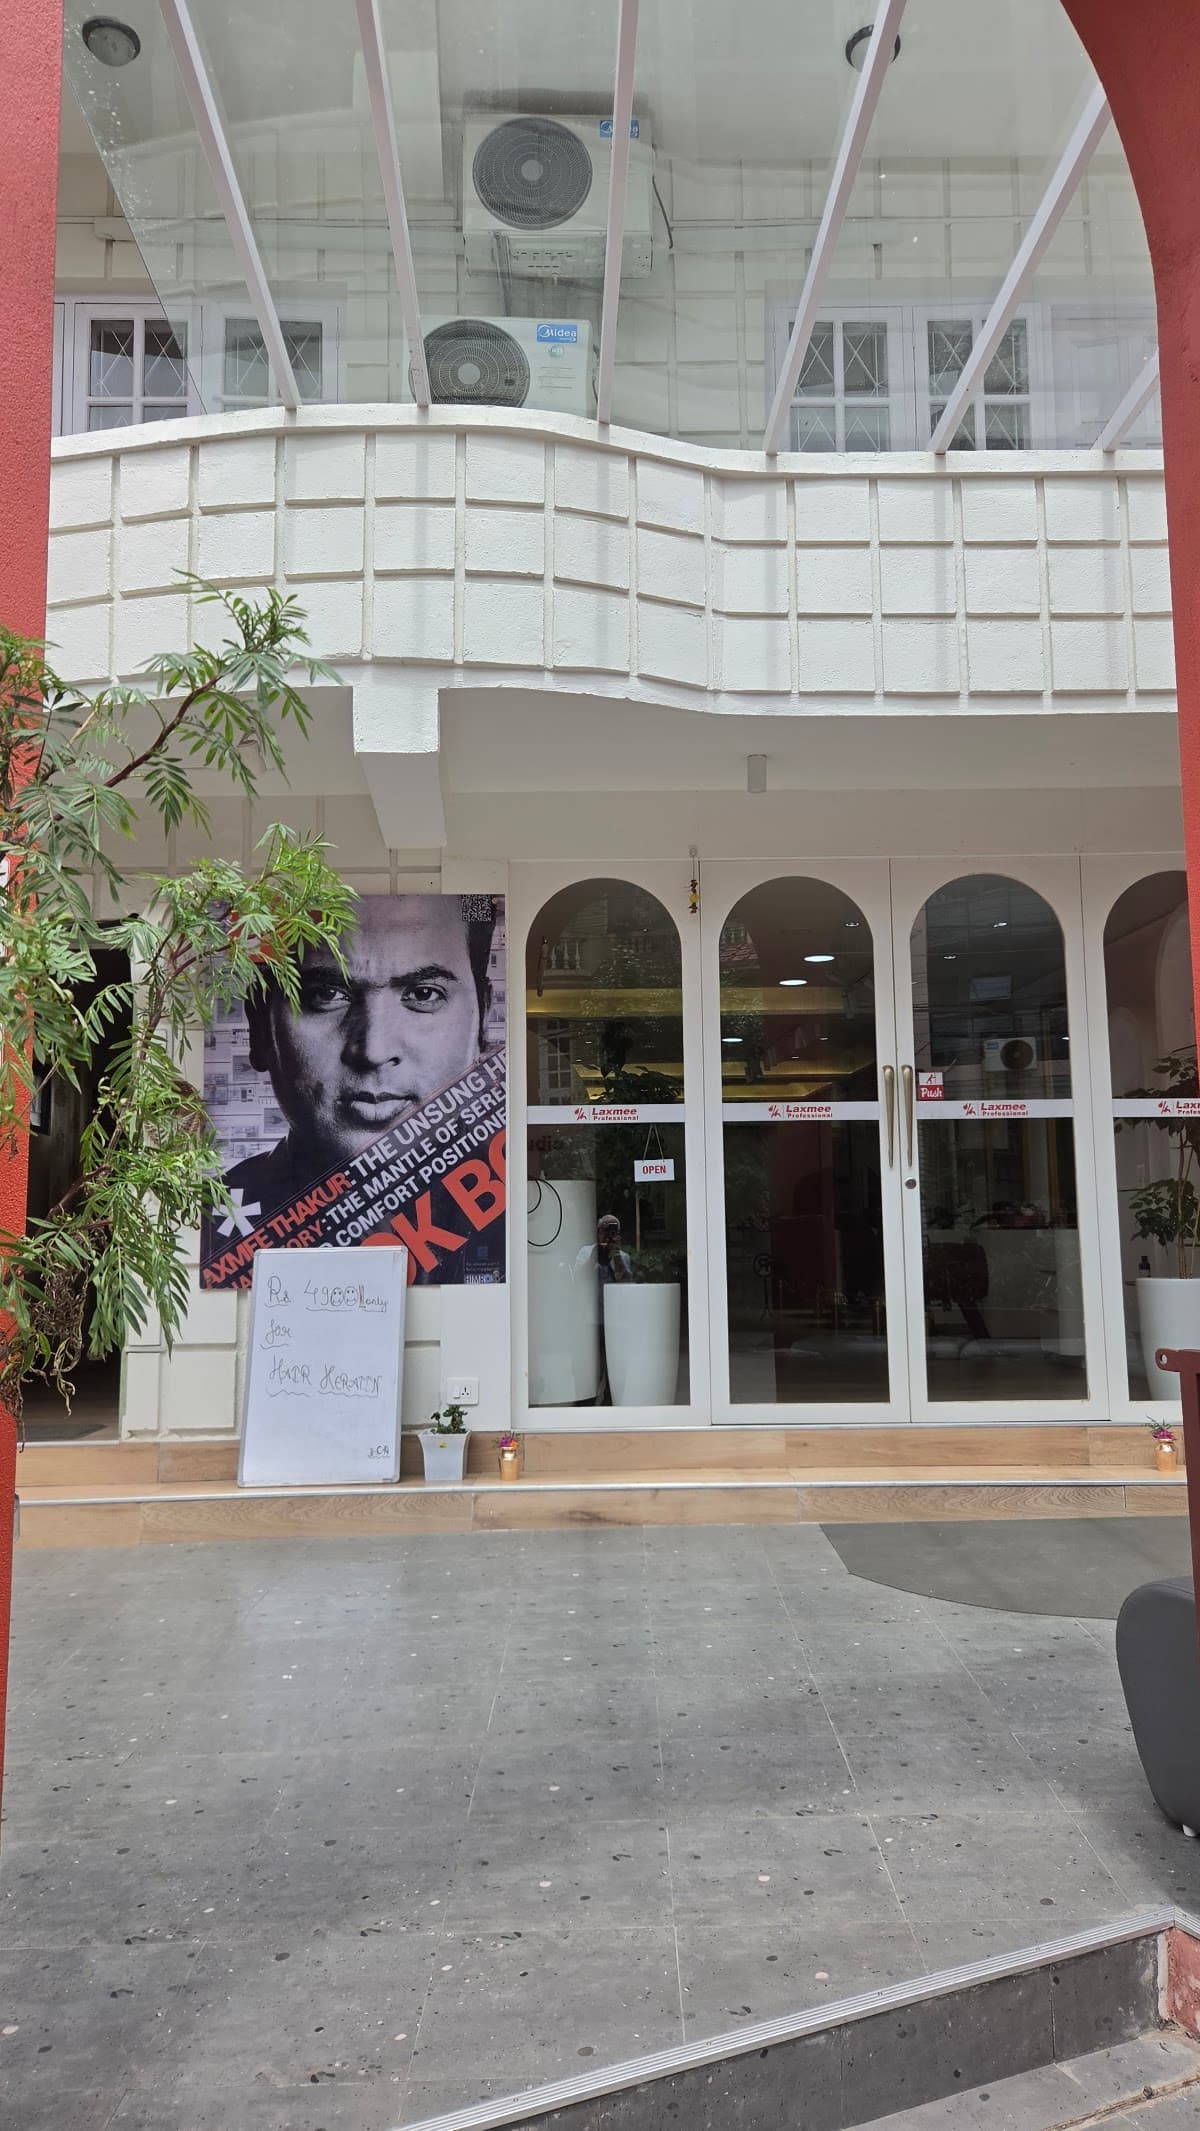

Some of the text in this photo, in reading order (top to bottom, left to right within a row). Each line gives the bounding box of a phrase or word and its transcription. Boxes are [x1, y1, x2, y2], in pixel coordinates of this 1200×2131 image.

[538, 325, 577, 338] Midea
[920, 1087, 943, 1098] Push
[592, 1107, 637, 1116] Laxmee
[786, 1104, 832, 1113] Laxmee
[981, 1102, 1026, 1111] Laxmee
[349, 1136, 398, 1177] THE
[393, 1071, 486, 1145] UNSUNG
[326, 1191, 366, 1225] THE
[363, 1137, 437, 1199] MANTLE
[435, 1118, 459, 1144] OF
[642, 1165, 667, 1174] OPEN
[335, 1175, 420, 1247] COMFORT
